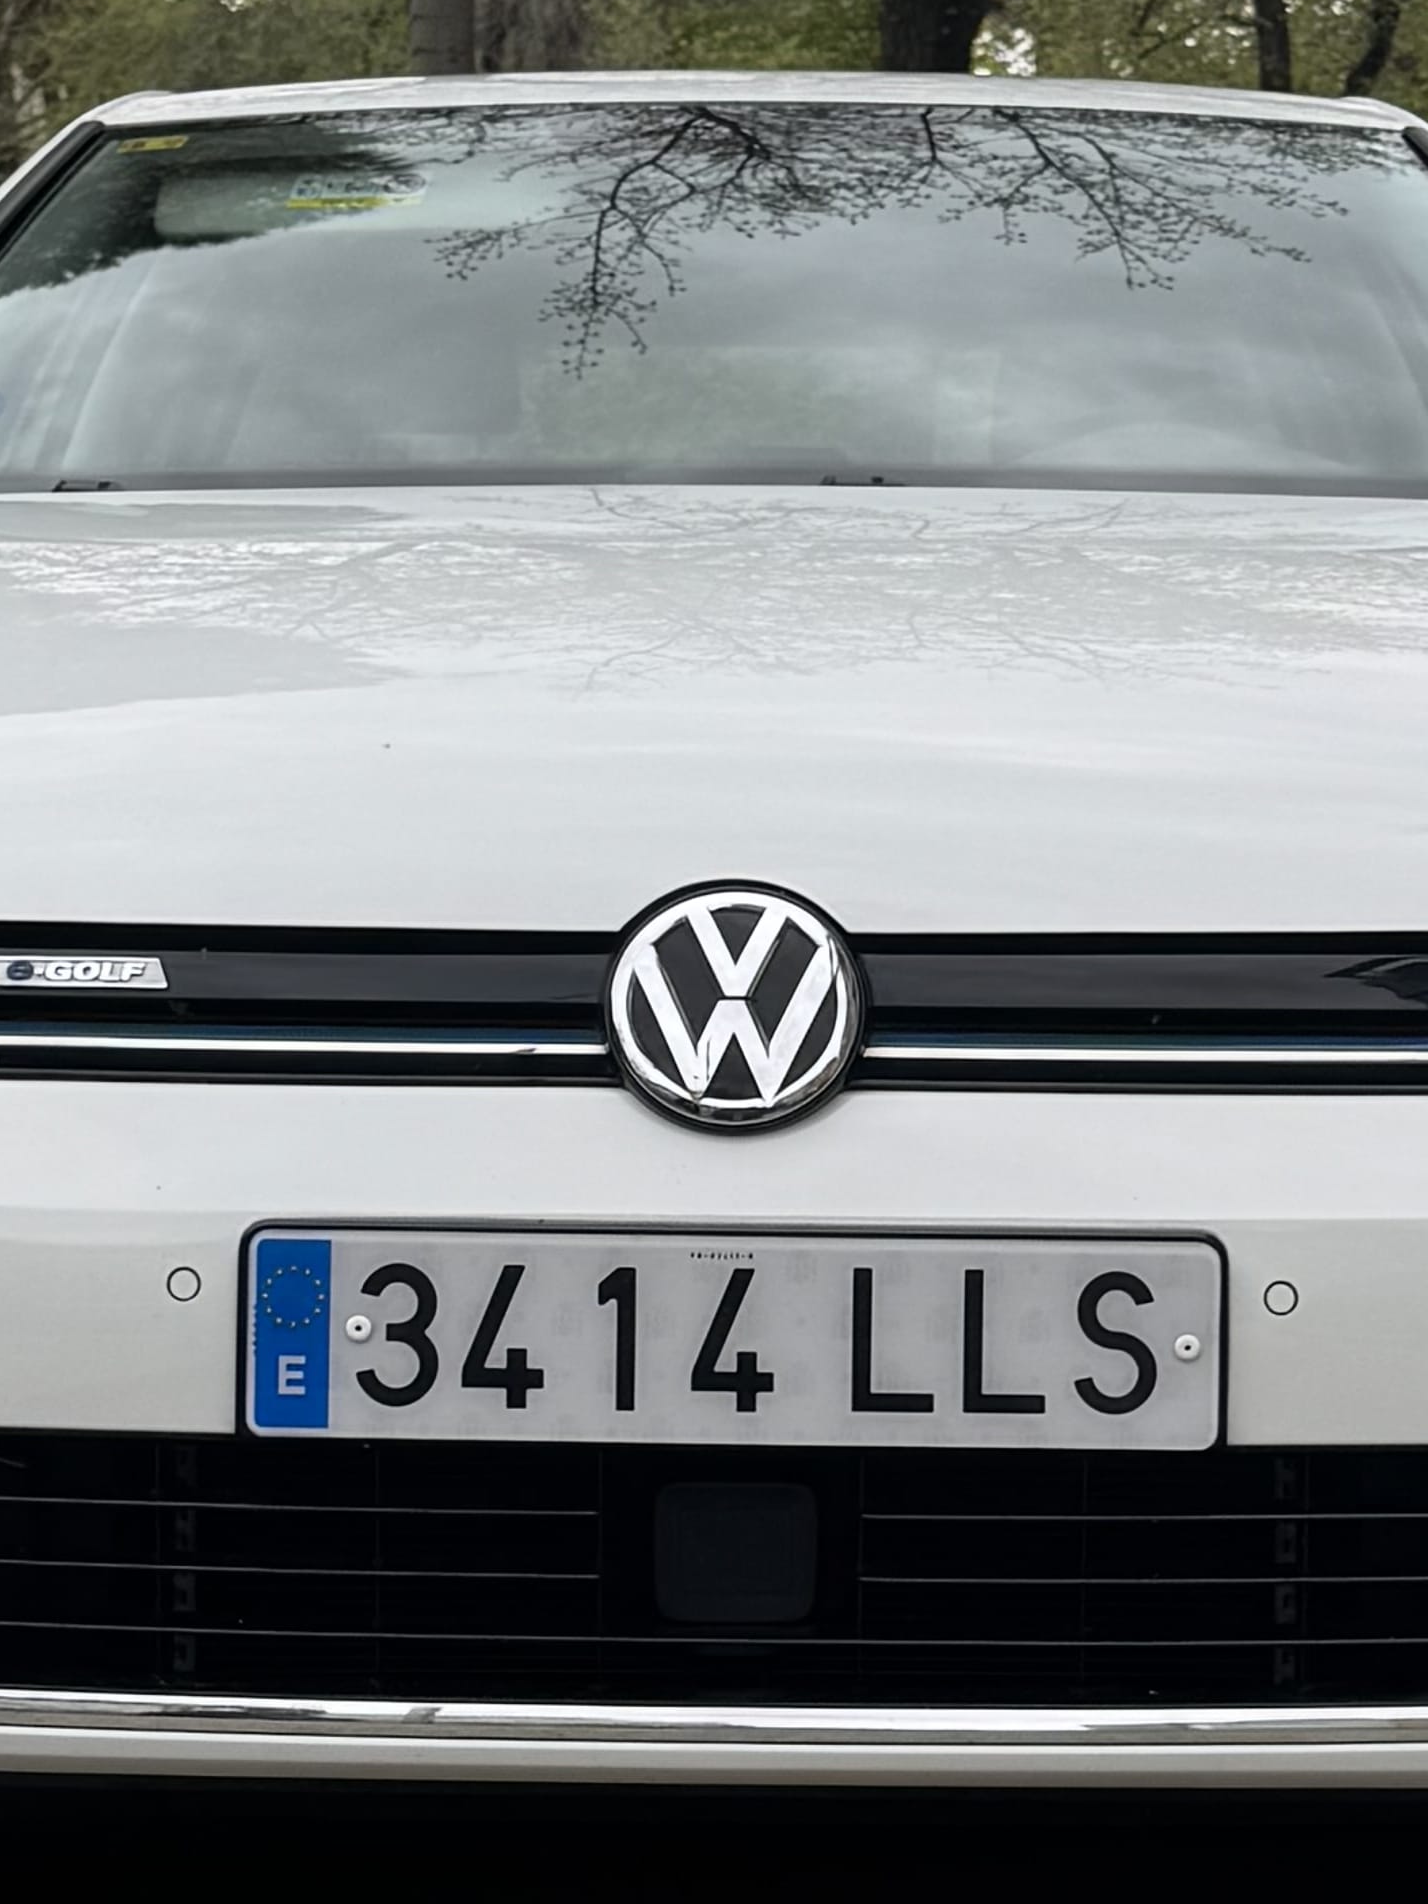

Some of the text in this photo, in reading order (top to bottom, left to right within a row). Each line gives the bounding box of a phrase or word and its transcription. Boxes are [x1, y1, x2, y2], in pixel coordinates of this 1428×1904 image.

[621, 899, 847, 1111] VW
[278, 1355, 306, 1395] E
[356, 1263, 1158, 1415] 3414 LLS
